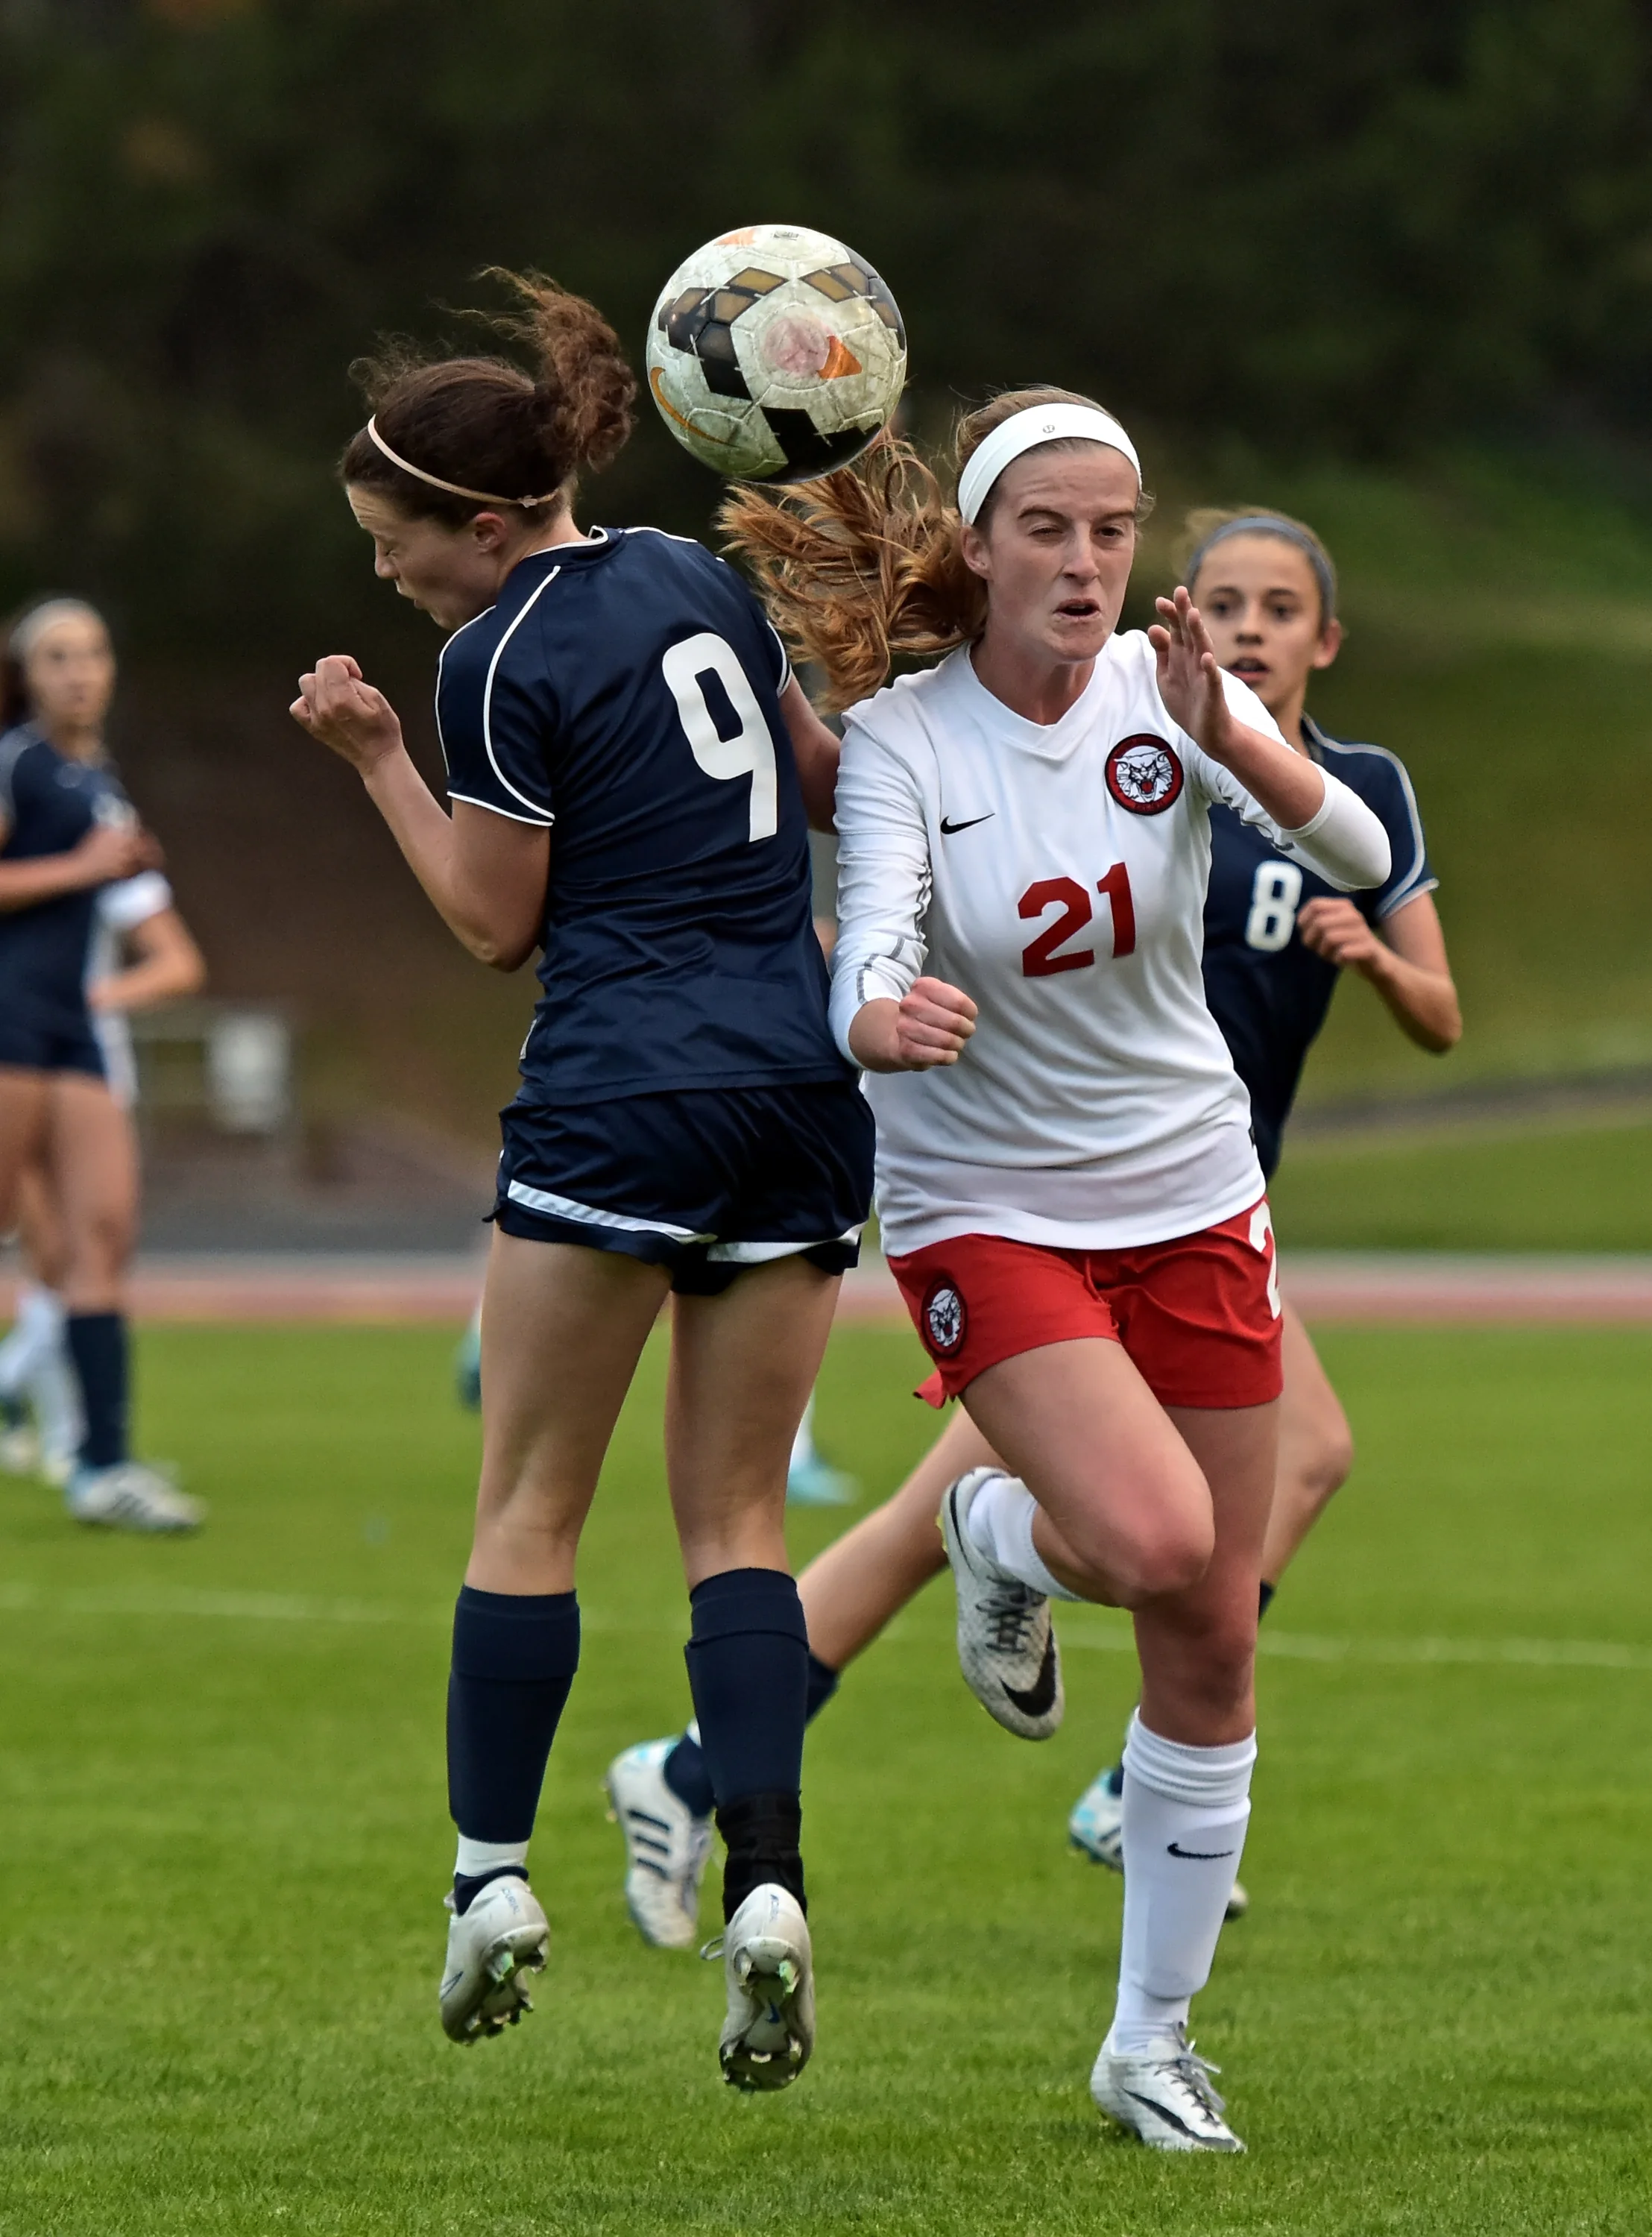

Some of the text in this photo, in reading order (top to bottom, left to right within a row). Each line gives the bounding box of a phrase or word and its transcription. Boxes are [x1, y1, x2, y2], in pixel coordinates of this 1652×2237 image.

[662, 632, 777, 842] 9
[1018, 861, 1136, 977] 21
[1244, 860, 1303, 952] 8
